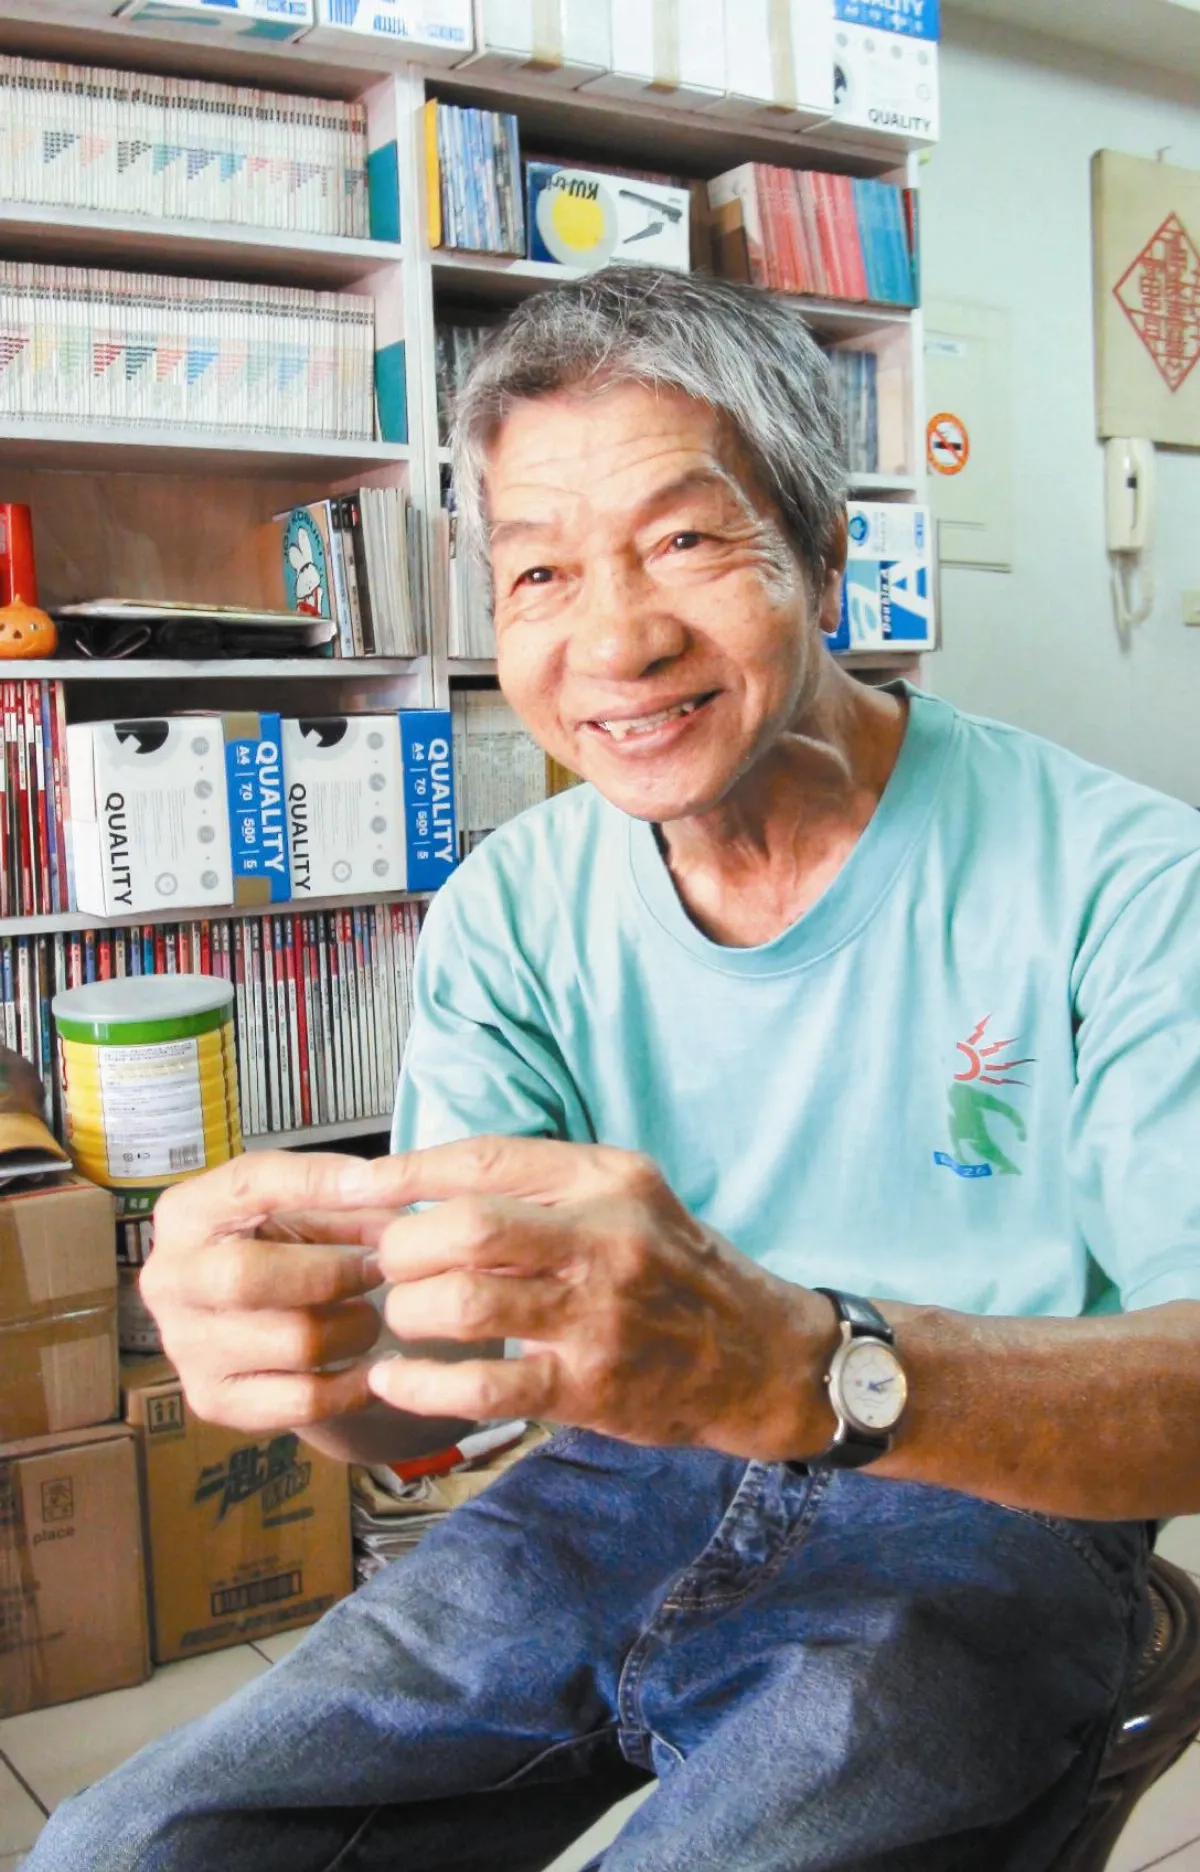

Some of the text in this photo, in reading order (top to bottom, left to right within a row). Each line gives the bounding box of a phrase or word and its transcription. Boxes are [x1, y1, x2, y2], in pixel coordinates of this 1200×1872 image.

[868, 108, 931, 132] QUALITY
[239, 745, 250, 765] A4
[414, 742, 425, 761] A4
[242, 782, 253, 801] 70
[416, 777, 426, 795] 70
[256, 740, 285, 873] QUALITY
[428, 738, 453, 863] QUALITY
[243, 817, 256, 844] 500
[288, 783, 311, 891] QUALITY
[104, 792, 132, 906] QUALITY
[32, 1525, 76, 1548] place
